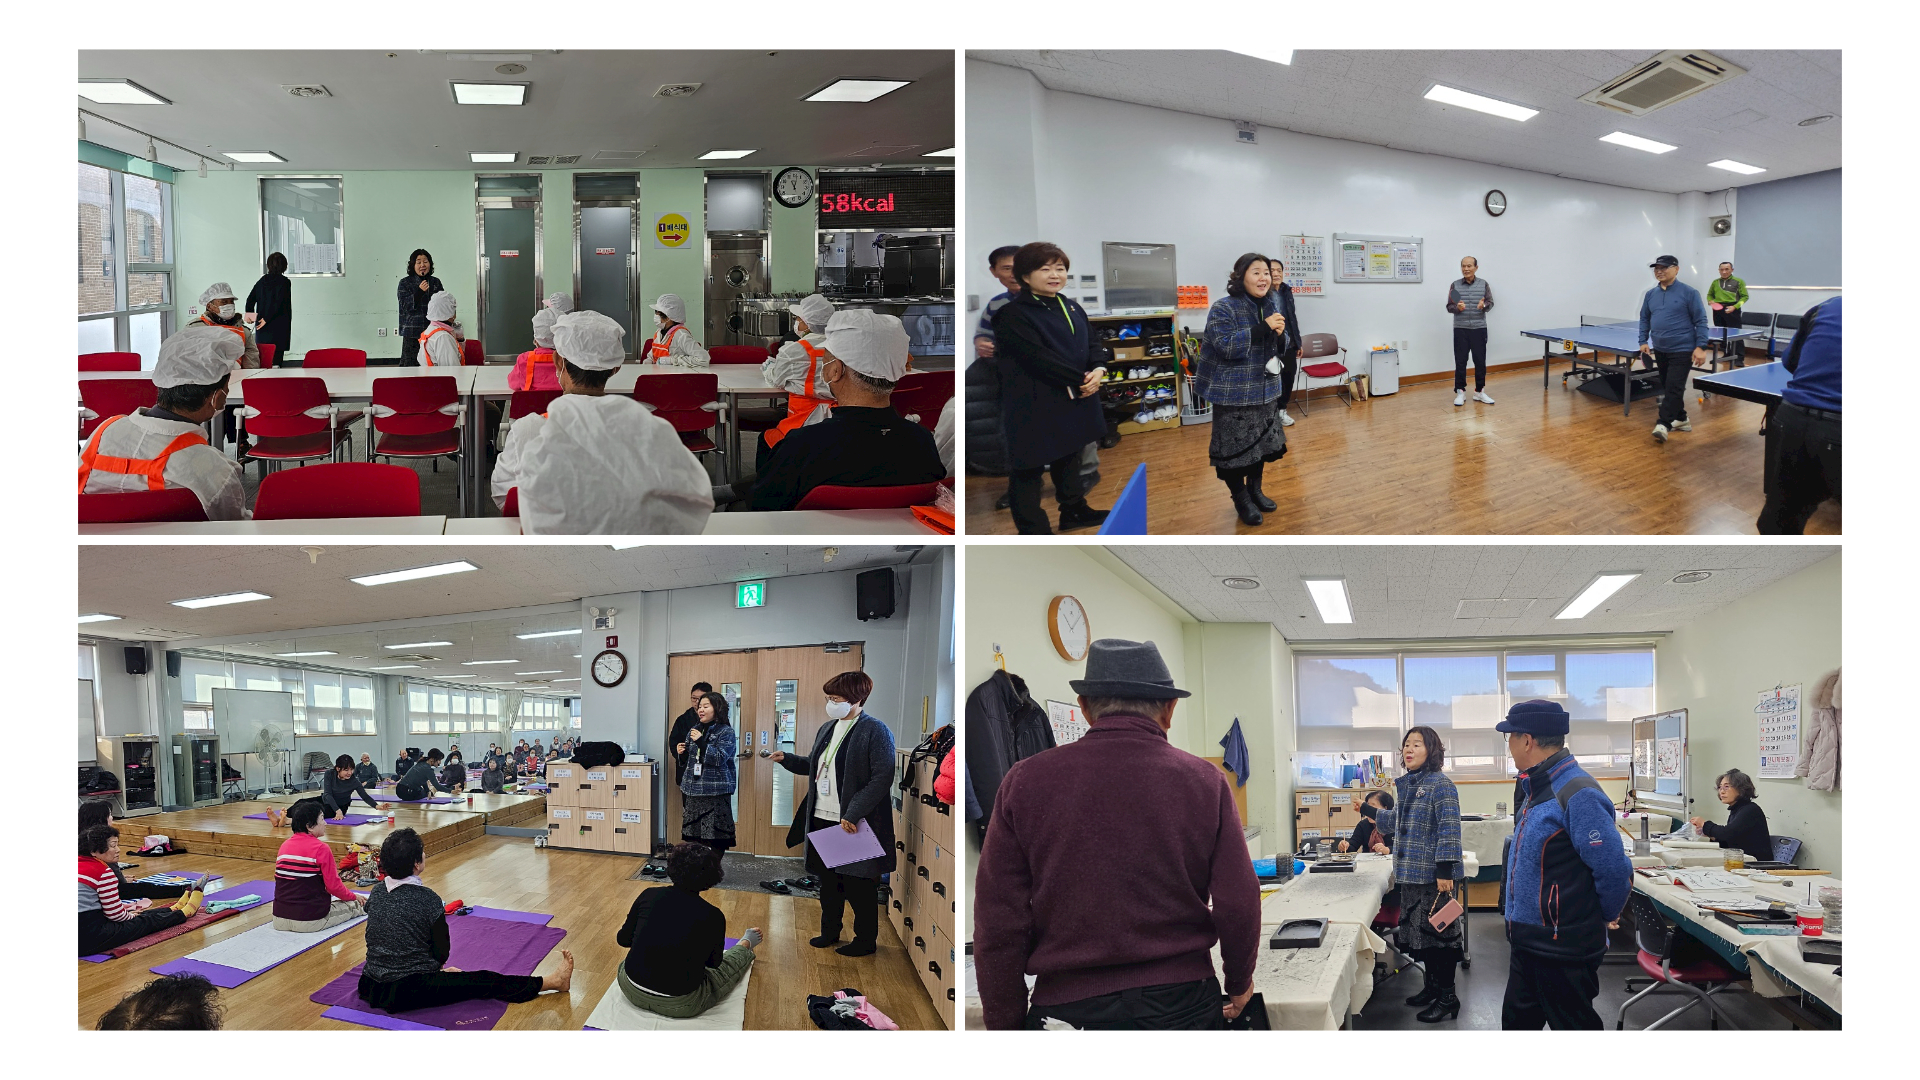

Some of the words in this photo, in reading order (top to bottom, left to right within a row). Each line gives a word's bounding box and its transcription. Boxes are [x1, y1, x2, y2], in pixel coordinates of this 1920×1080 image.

[820, 192, 894, 212] 58kcal
[667, 223, 687, 231] 배식대
[1566, 341, 1570, 349] 5
[1070, 709, 1075, 721] 1
